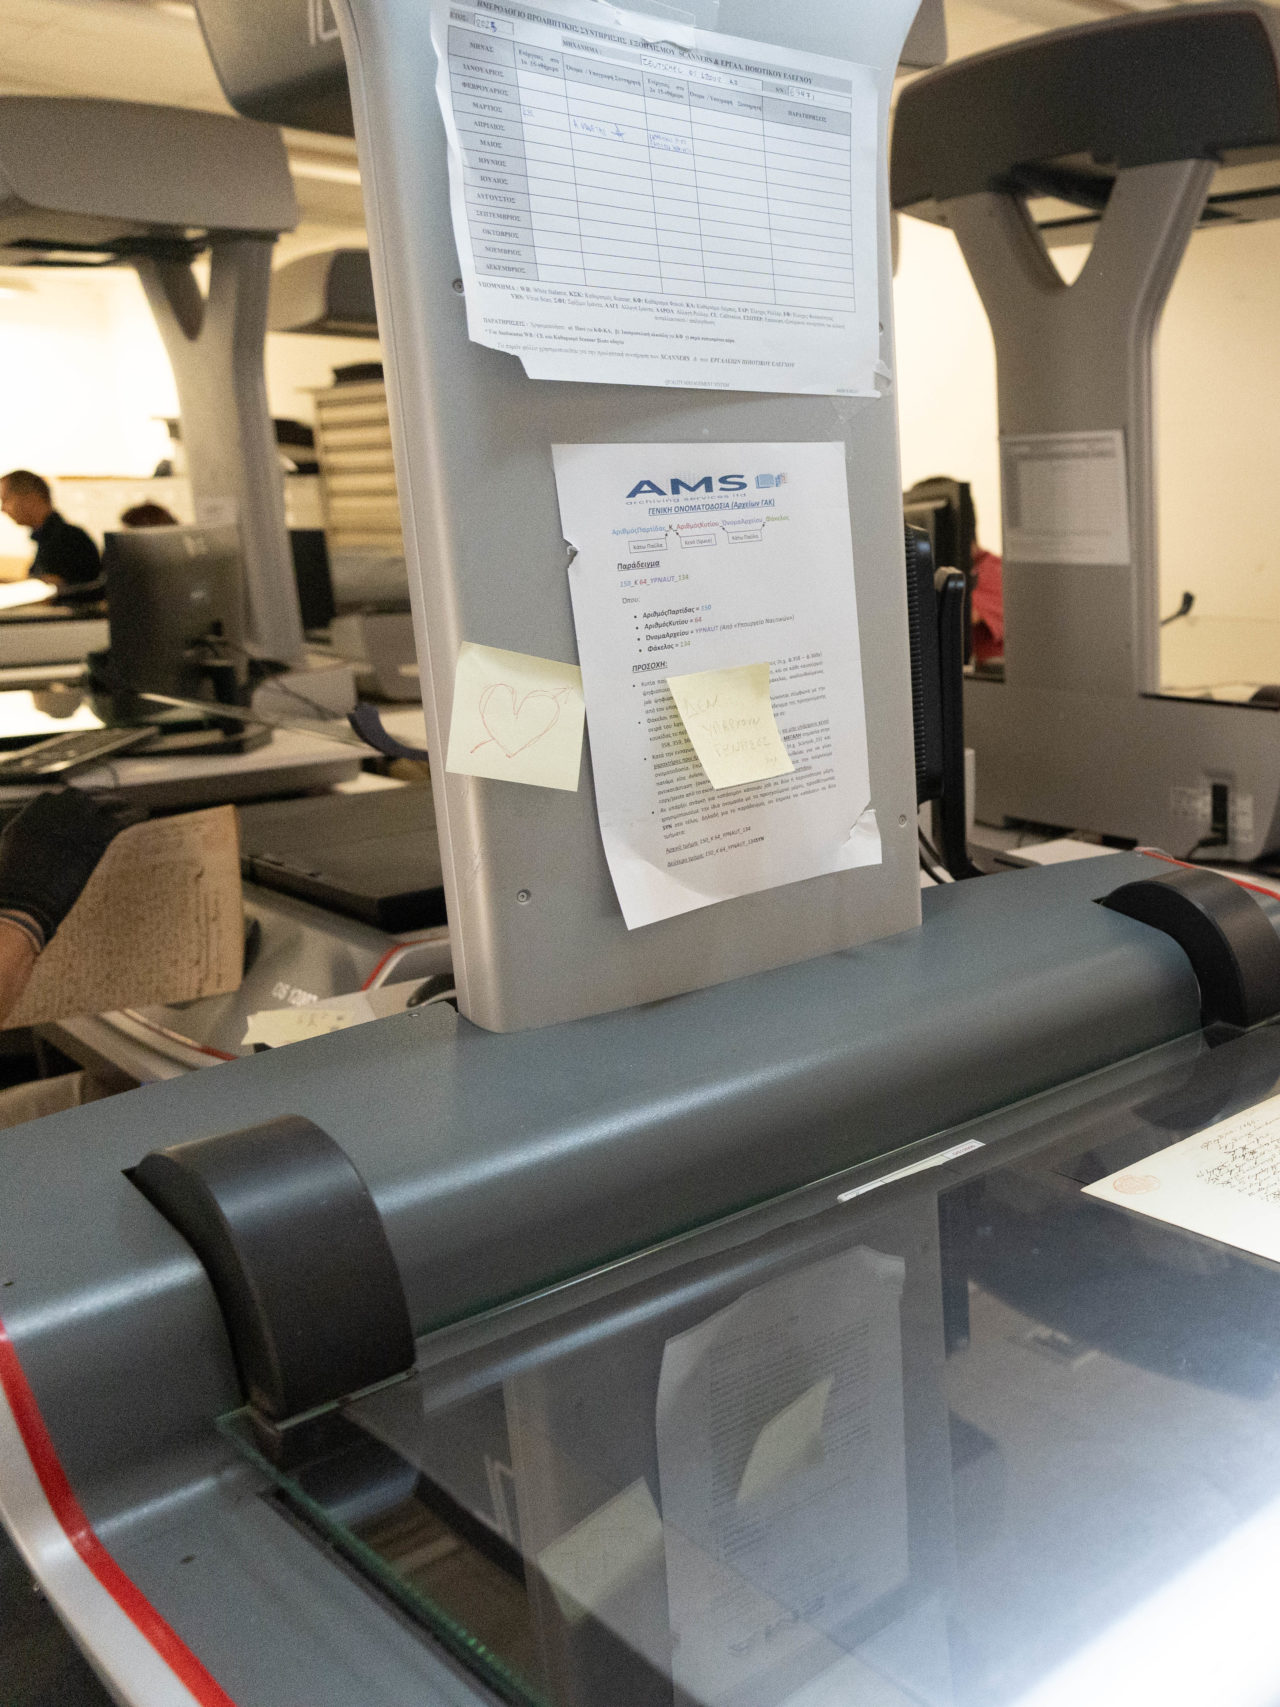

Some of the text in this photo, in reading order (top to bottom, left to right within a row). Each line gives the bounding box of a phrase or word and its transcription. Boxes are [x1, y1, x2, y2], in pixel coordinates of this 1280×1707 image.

[470, 42, 494, 53] ΜΗΝΑΣ
[463, 63, 504, 77] ΙΑΝΟΥΑΡΙΟΣ
[462, 82, 509, 96] ΦΕΒΡΟΥΑΡΙΟΣ
[473, 102, 503, 113] ΜΑΡΤΙΟΣ
[480, 139, 503, 148] ΜΑΙΟΣ
[479, 157, 507, 167] ΙΟΥΝΙΟΣ
[480, 175, 509, 185] ΙΟΥΛΙΟΣ
[477, 193, 516, 203] ΑΥΓΟΥΣΤΟΣ
[482, 229, 520, 239] ΟΚΤΩΒΡΙΟΣ
[485, 246, 522, 256] ΝΟΕΜΒΡΙΟΣ
[486, 264, 526, 273] ΔΕΚΕΜΒΡΙΟΣ
[625, 474, 748, 499] AMS
[683, 493, 729, 503] services
[648, 507, 673, 516] ΓΕΝΙΚΗ
[673, 503, 730, 514] ΟΝΟΜΑΤΟΔΟΣΙΑ
[761, 499, 775, 507] ΓΑΚ)
[617, 560, 660, 571] Παράδειγμα
[643, 606, 695, 620] ΑριθμόςΠαρτίδας
[644, 618, 689, 630] ΑριθμόςΚυτίου
[647, 643, 674, 652] Φάκελος
[632, 660, 668, 673] ΠΡΟΣΟΧΗ:
